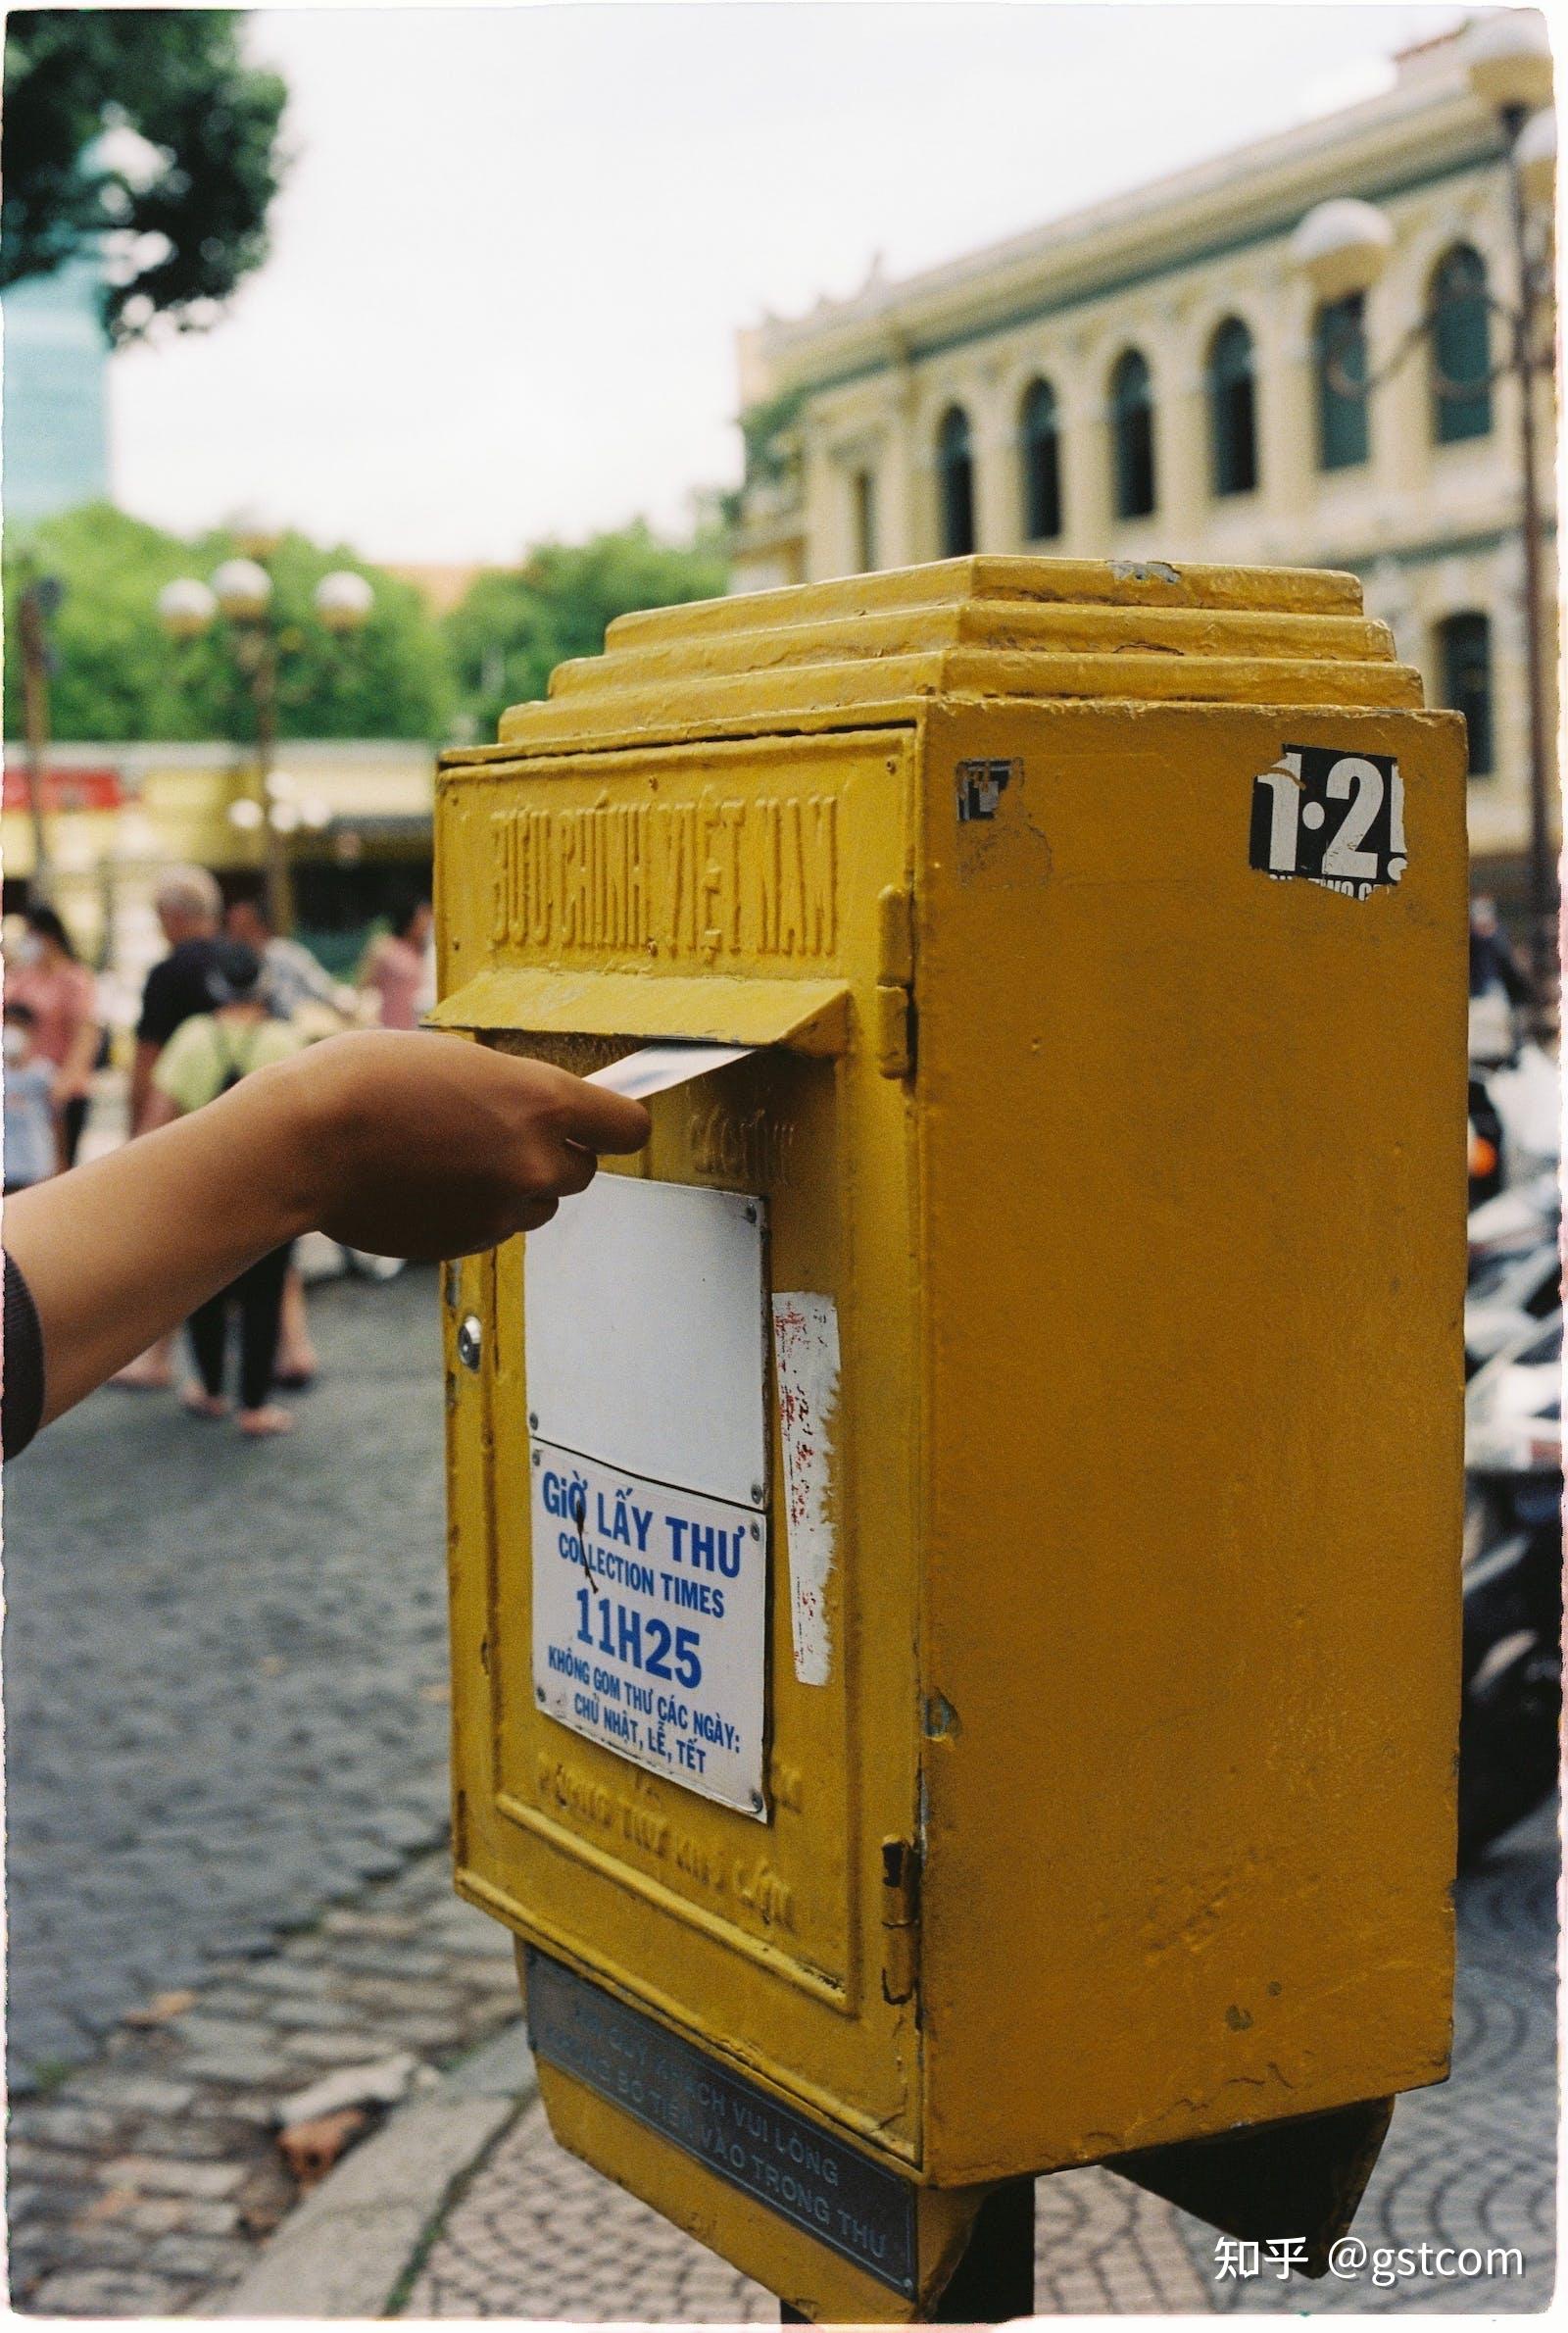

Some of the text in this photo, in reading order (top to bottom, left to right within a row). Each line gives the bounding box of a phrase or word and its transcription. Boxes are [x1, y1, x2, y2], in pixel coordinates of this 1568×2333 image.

[559, 789, 653, 954] CHÍNH
[756, 795, 838, 958] NAM
[559, 1532, 724, 1618] COLLECTION TIMES
[597, 1487, 653, 1552] LẤY
[665, 1515, 746, 1578] THƯ
[577, 1587, 702, 1689] 11H25
[548, 1644, 740, 1754] KHÔNG GOM THƯ CÁC NGÀY:
[574, 1692, 600, 1725] CHỦ
[676, 1737, 707, 1773] TẾT
[732, 2101, 768, 2144] VUI
[752, 2155, 830, 2225] TRONG
